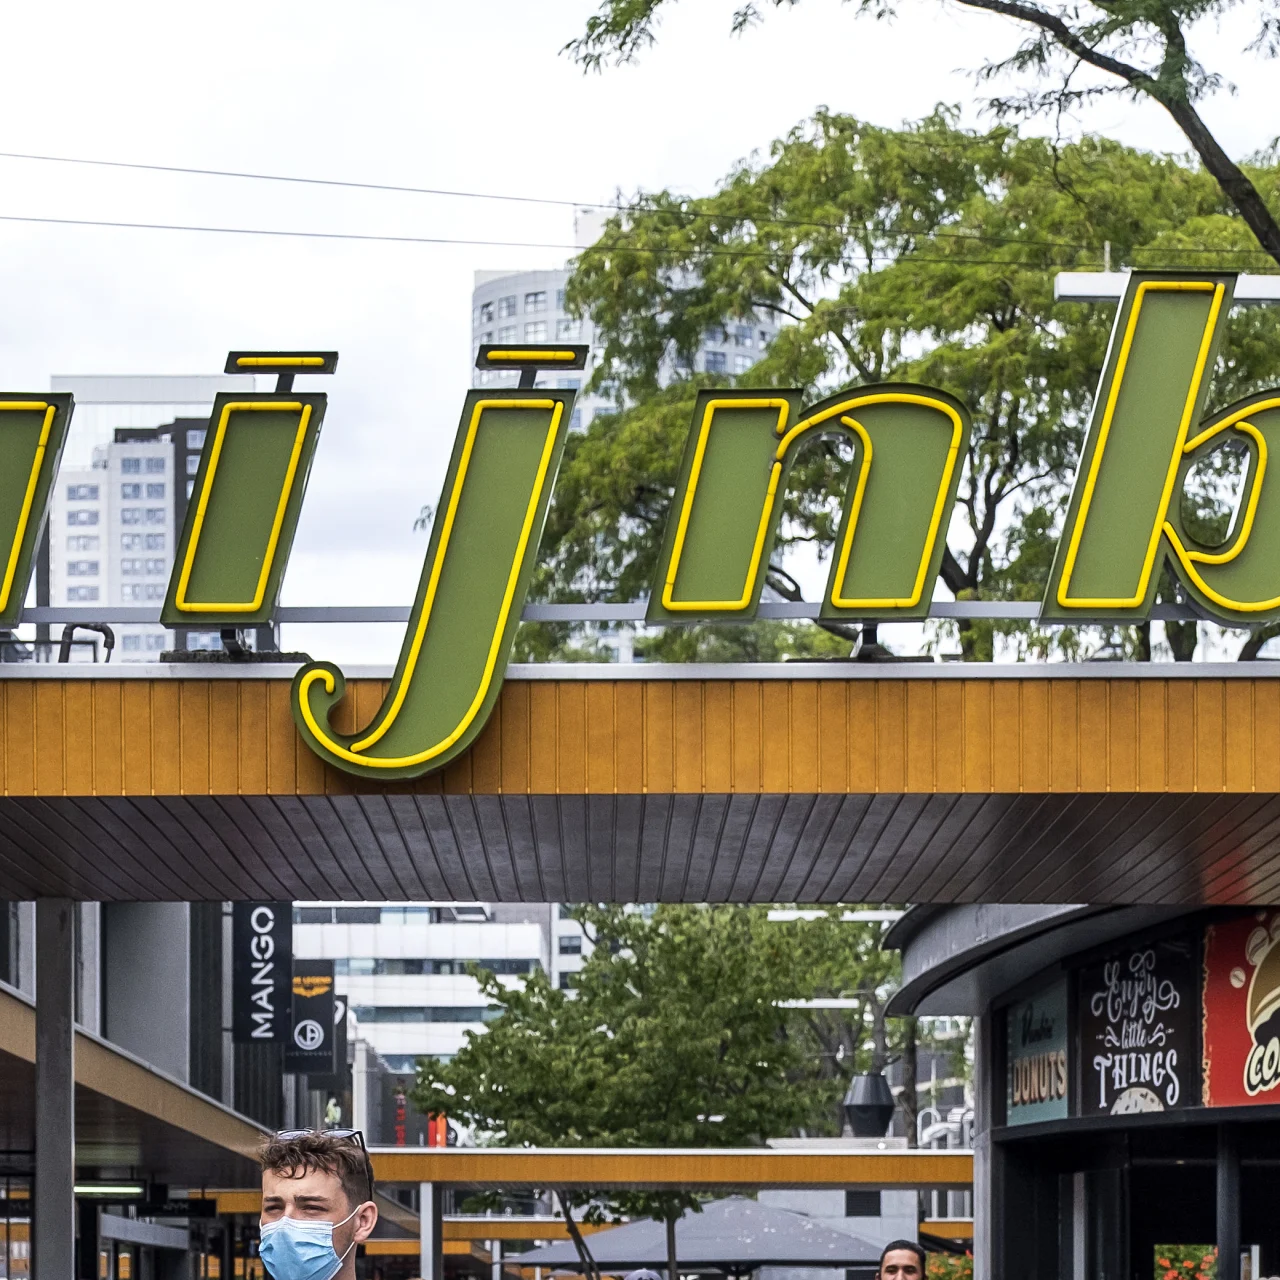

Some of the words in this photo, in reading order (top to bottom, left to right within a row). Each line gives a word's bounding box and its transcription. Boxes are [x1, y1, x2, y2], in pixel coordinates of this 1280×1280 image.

[250, 906, 275, 1039] MANGO
[1091, 949, 1180, 1024] Enjoy
[1120, 1017, 1148, 1049] little
[1012, 1049, 1067, 1107] DONUTS
[1093, 1048, 1180, 1109] THINGS
